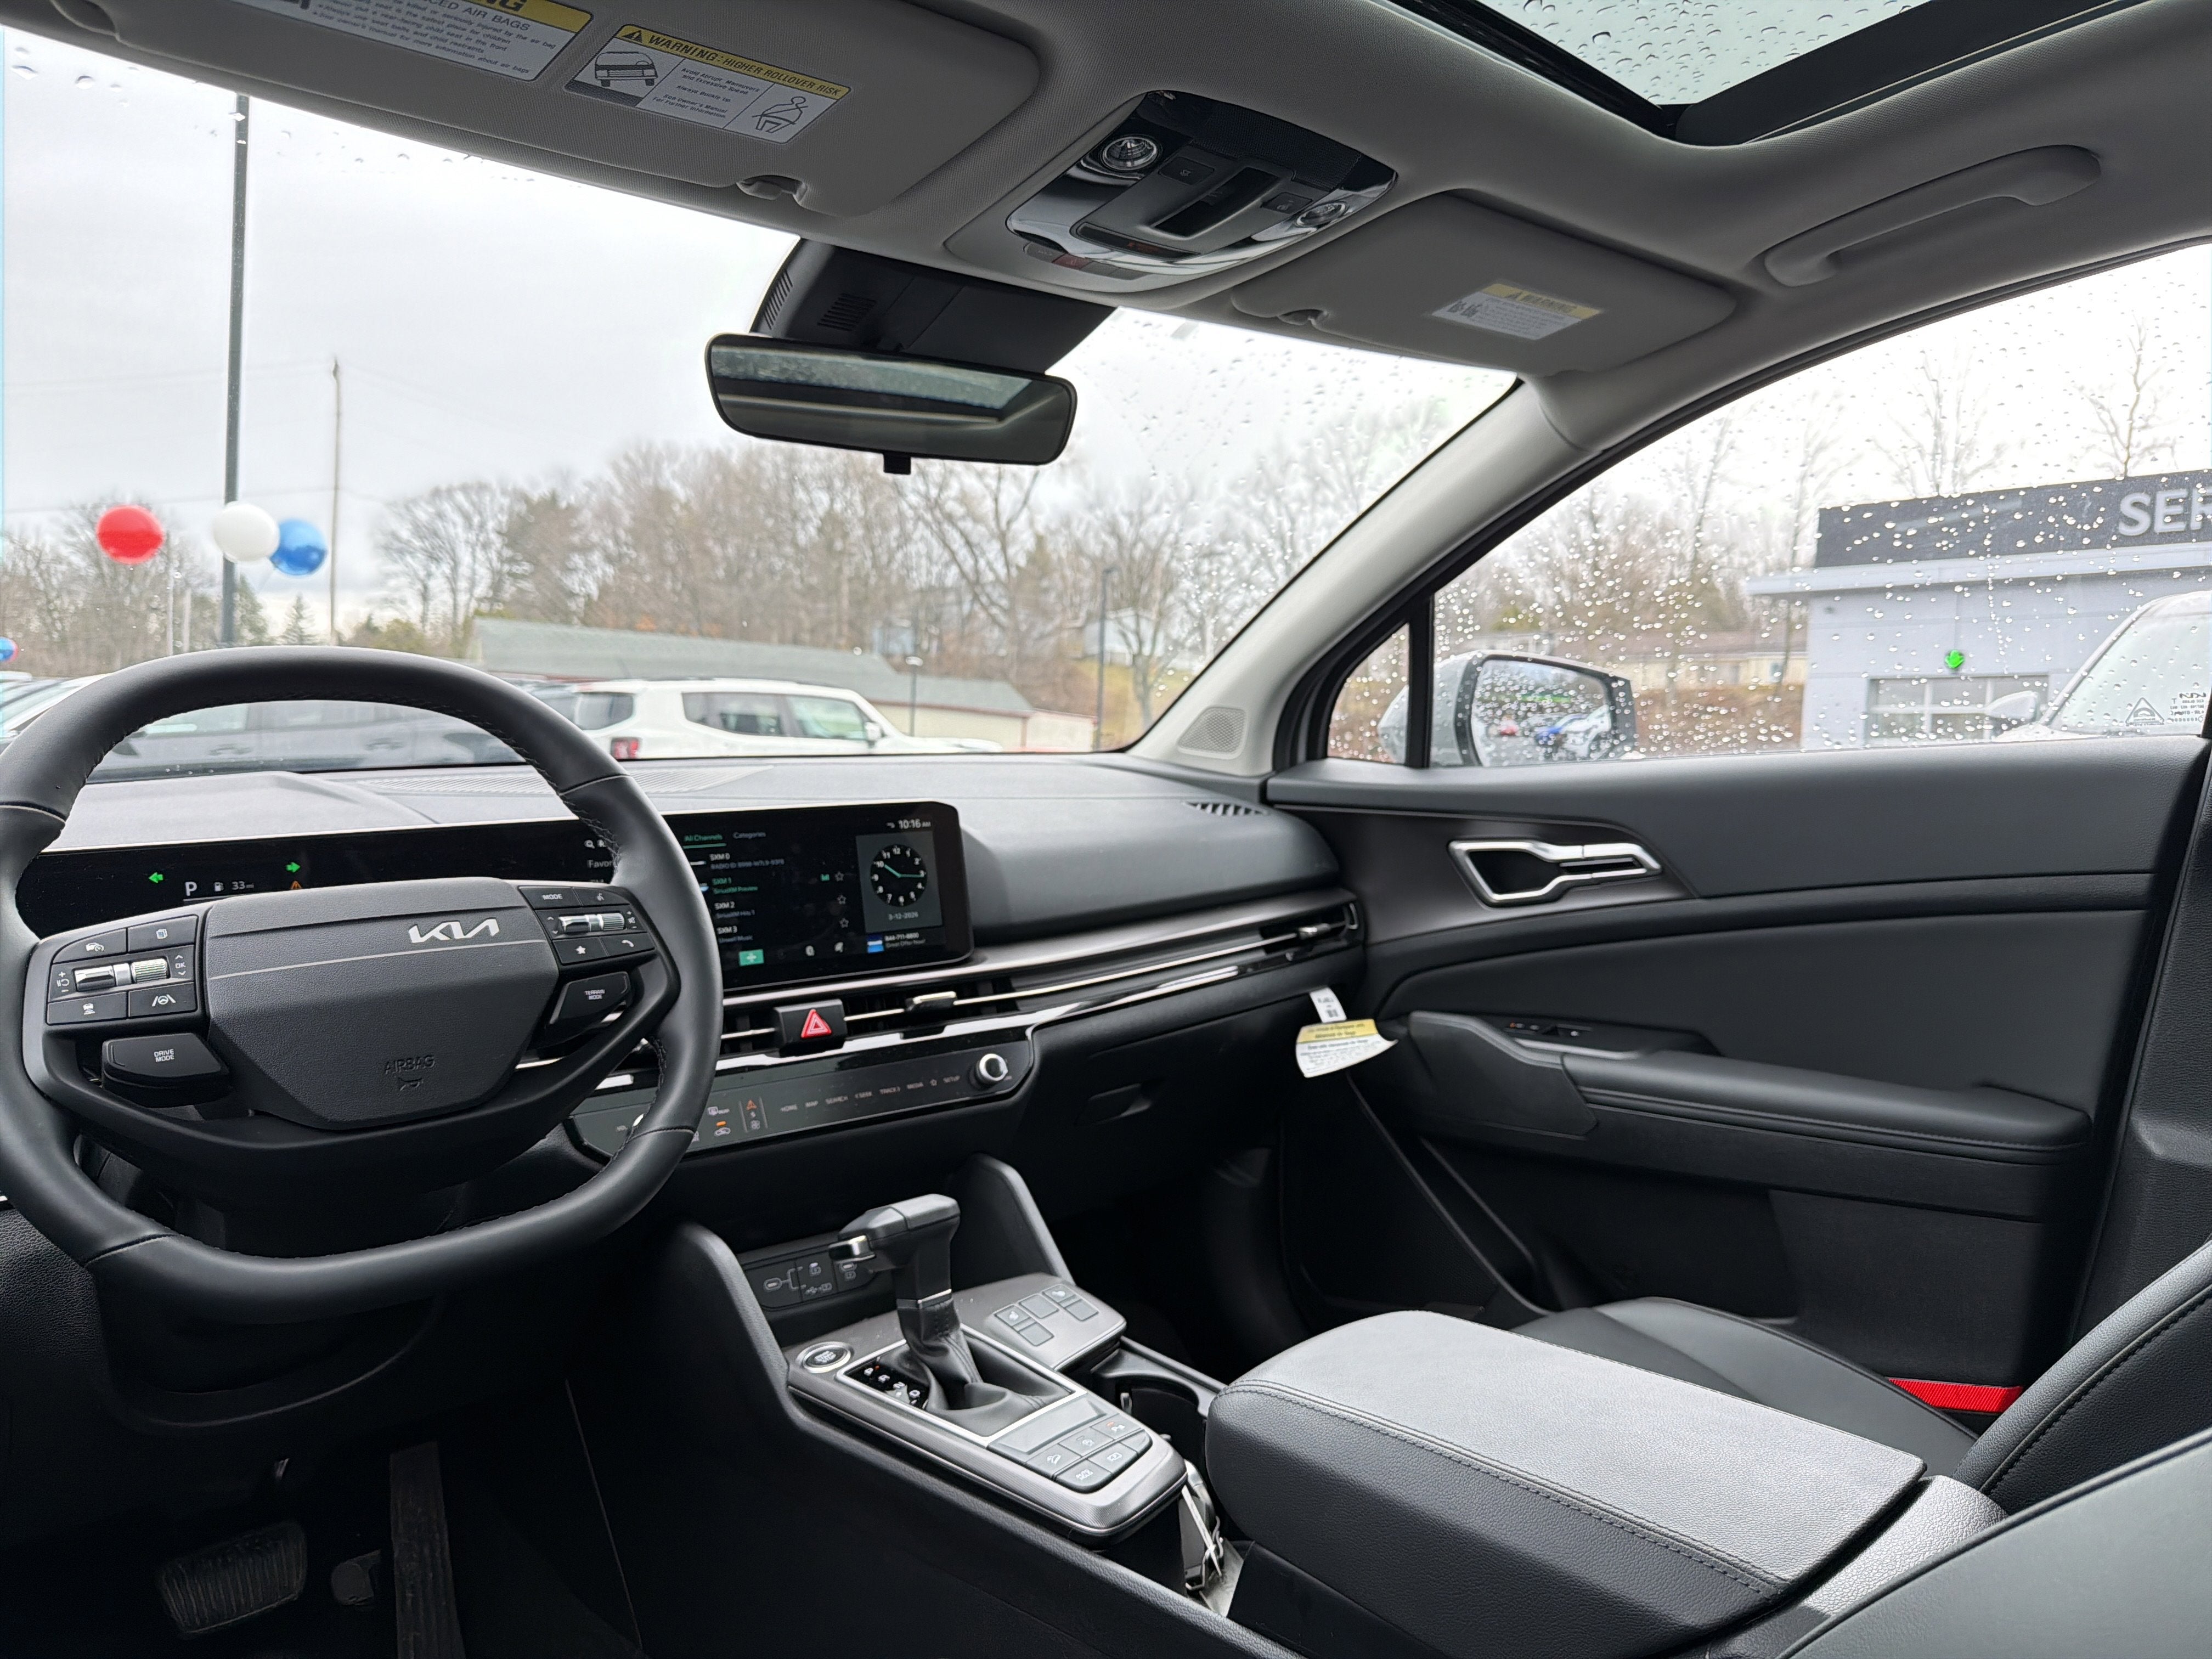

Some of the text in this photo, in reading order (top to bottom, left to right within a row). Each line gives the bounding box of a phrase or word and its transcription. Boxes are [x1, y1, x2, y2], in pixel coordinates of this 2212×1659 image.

[462, 7, 488, 19] AIR
[492, 14, 531, 31] BAGS
[422, 16, 445, 25] safest
[447, 24, 466, 32] place
[483, 33, 511, 44] children
[442, 13, 474, 26] seriously
[477, 22, 503, 33] injured
[542, 41, 556, 49] bag
[449, 41, 484, 53] restraints
[489, 43, 507, 52] front
[436, 46, 475, 59] information
[512, 65, 529, 74] bags
[681, 67, 699, 76] Avoid
[701, 72, 723, 82] Abrupt
[723, 58, 764, 75] HIGHER
[764, 69, 816, 89] ROLLOVER
[817, 83, 842, 96] RISK
[675, 84, 699, 94] Always
[699, 91, 721, 100] Buckle
[727, 86, 748, 95] Speed
[664, 99, 689, 110] Further
[704, 104, 729, 114] Manual
[898, 819, 921, 829] 10:16
[893, 847, 901, 855] 12
[709, 853, 725, 861] SXM
[184, 881, 198, 896] P
[714, 887, 737, 895] SiriusXM
[714, 902, 730, 910] SXM
[408, 917, 500, 943] KIA
[717, 926, 732, 935] SXM
[154, 1048, 174, 1057] DRIVE
[155, 1054, 175, 1063] MODE
[385, 1054, 436, 1074] AIRBAG
[825, 1096, 848, 1104] SEARCH
